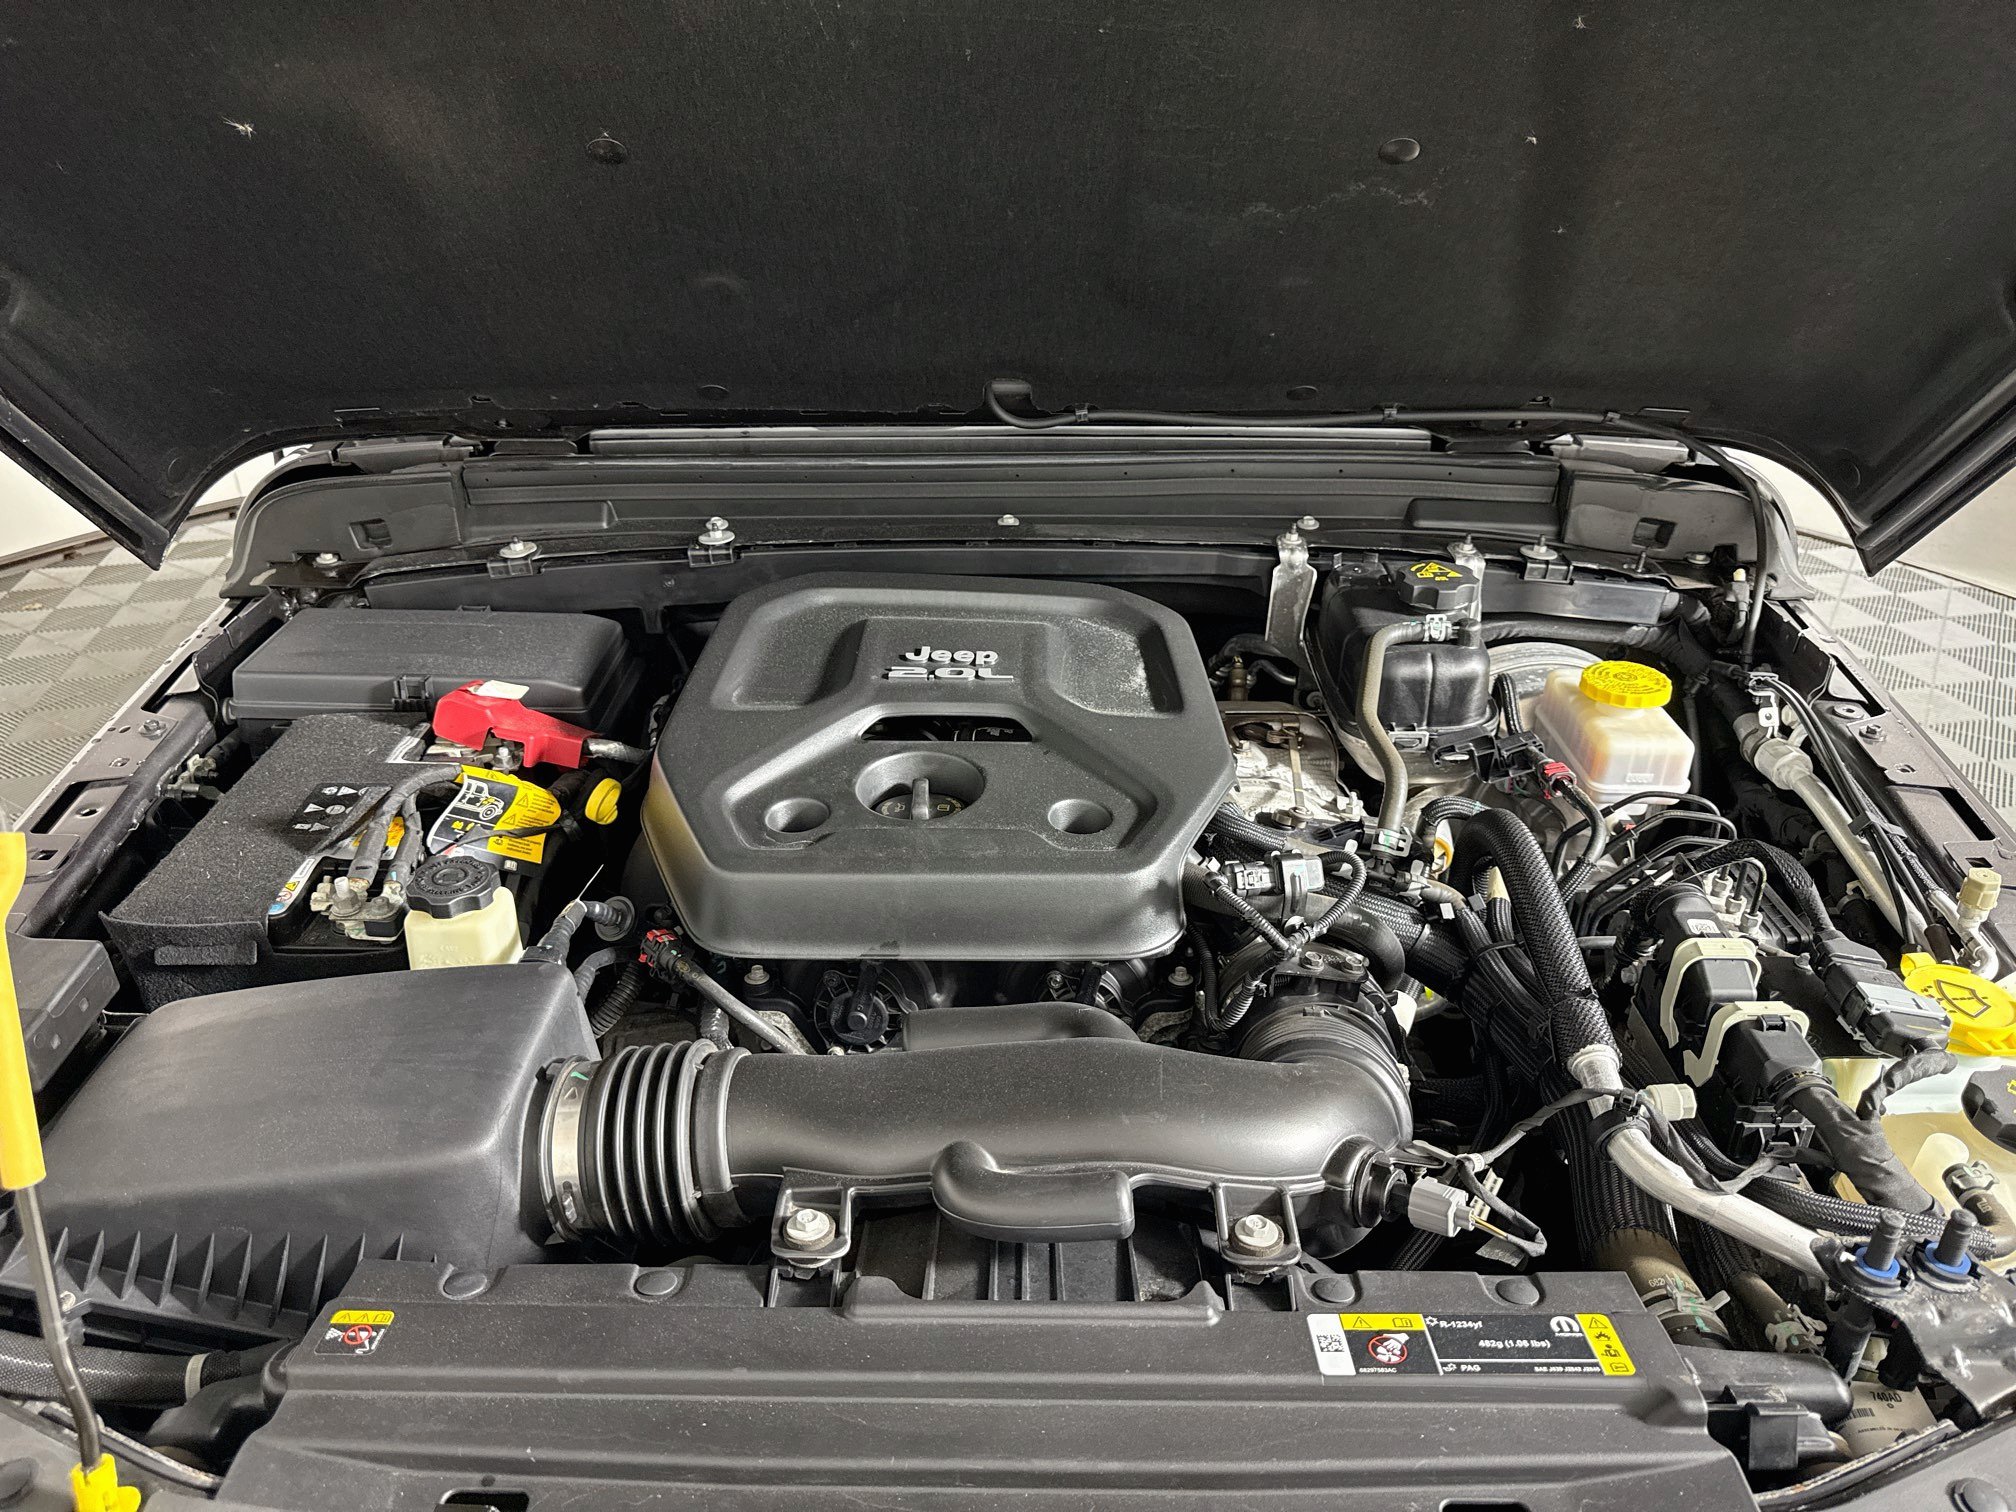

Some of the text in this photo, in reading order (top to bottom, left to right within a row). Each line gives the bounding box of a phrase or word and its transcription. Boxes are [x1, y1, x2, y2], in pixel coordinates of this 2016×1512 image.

[902, 646, 998, 666] Jeep
[886, 666, 1014, 681] 2.0L
[1530, 1339, 1551, 1349] lbs)
